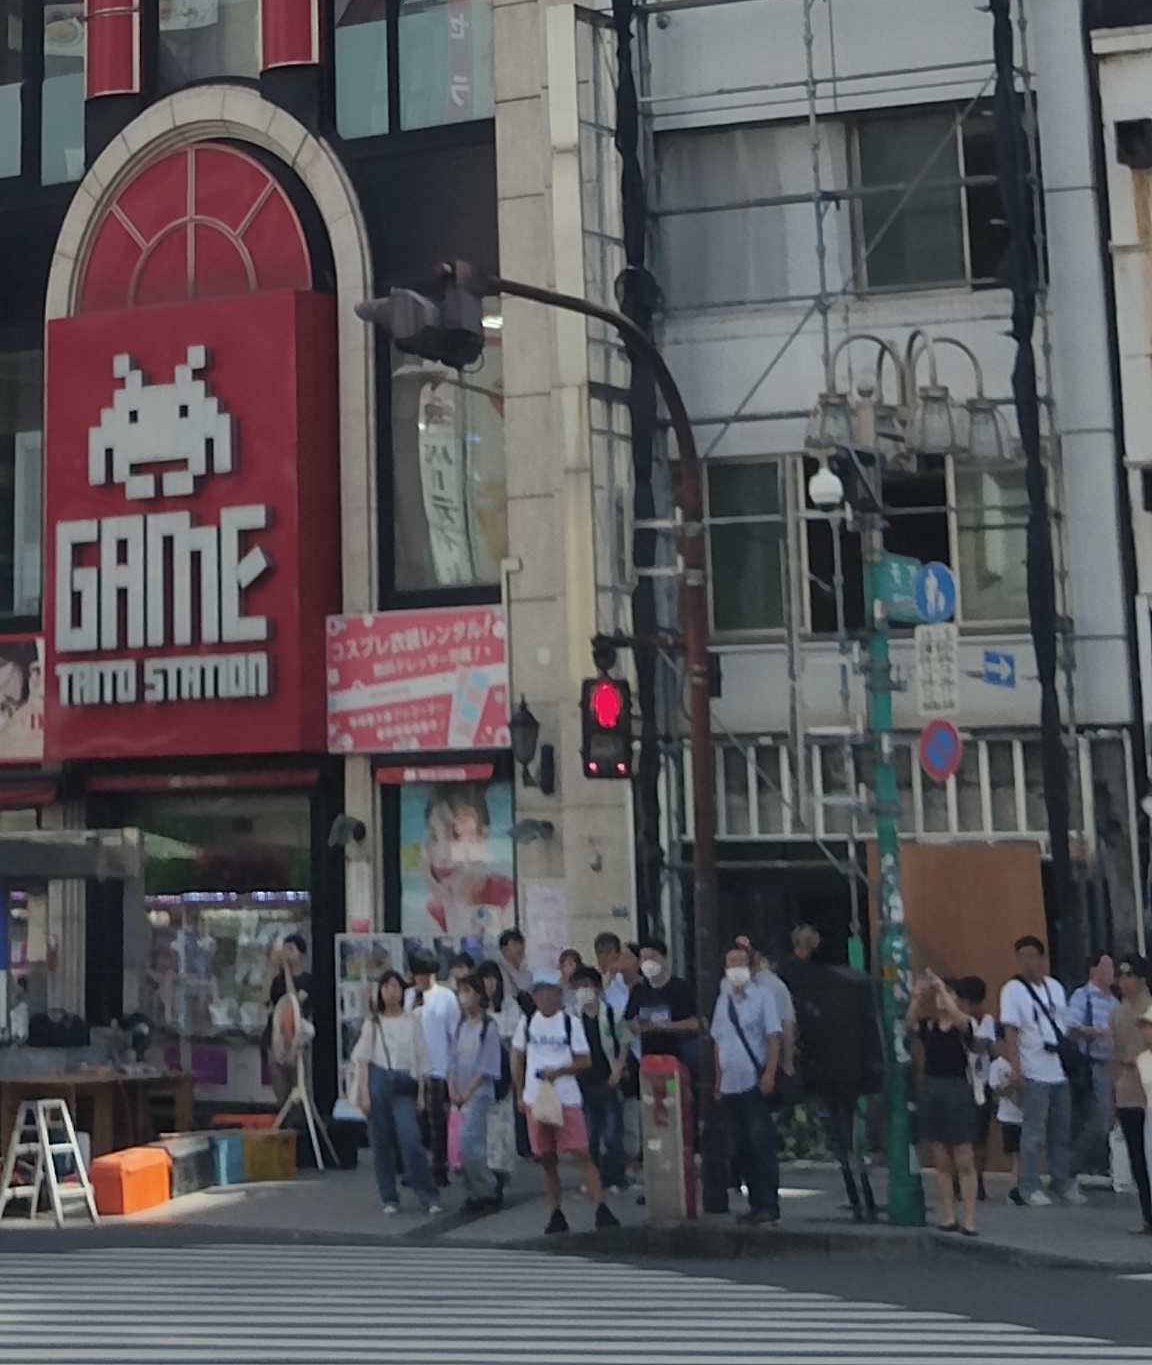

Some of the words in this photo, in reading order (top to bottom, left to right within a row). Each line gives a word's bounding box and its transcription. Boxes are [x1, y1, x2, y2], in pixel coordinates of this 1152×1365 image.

[55, 504, 269, 653] GAME
[56, 660, 137, 705] TAITO
[144, 652, 269, 702] STATION
